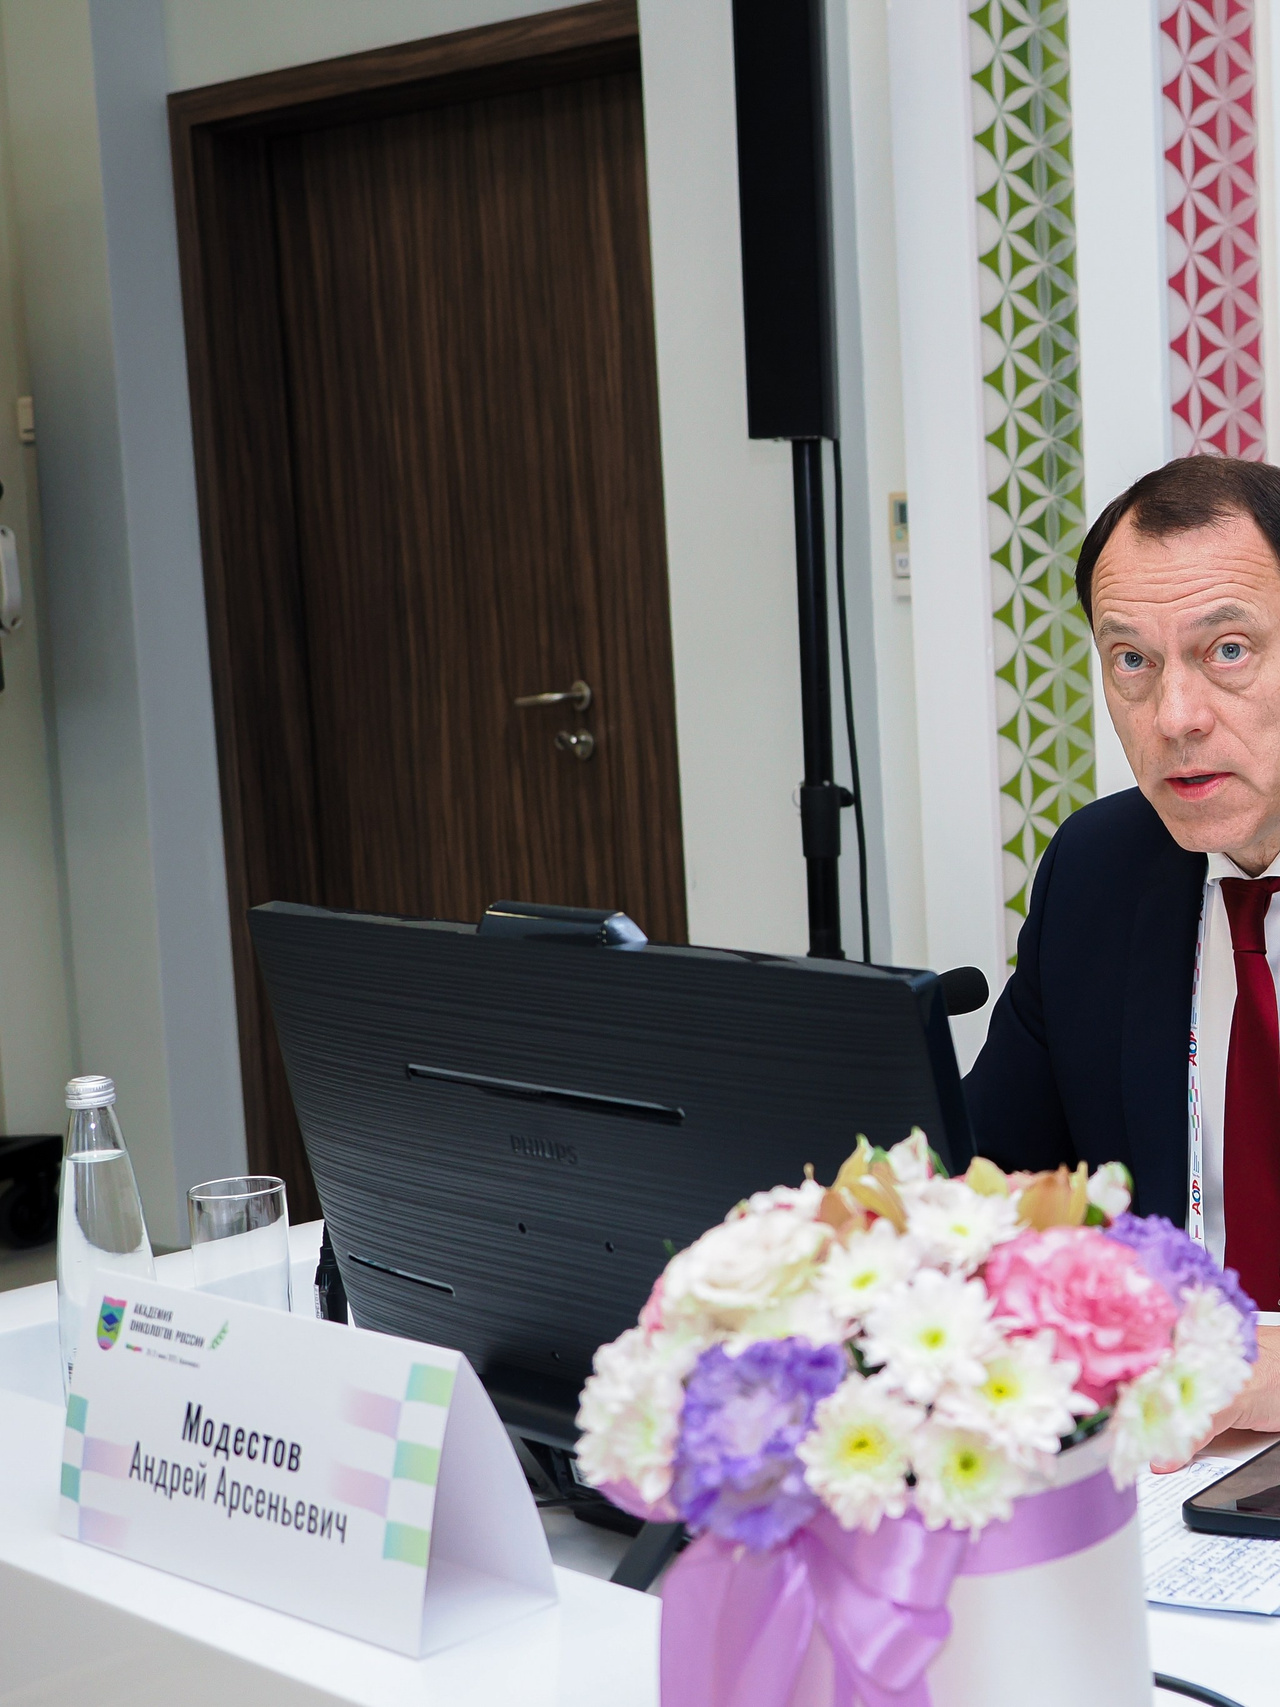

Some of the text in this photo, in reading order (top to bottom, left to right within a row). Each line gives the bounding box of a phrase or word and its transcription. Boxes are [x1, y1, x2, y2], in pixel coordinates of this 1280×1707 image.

[510, 1134, 578, 1165] PHILIPS
[181, 1400, 303, 1473] Модестов
[128, 1440, 348, 1545] Андрей Арсеньевич
